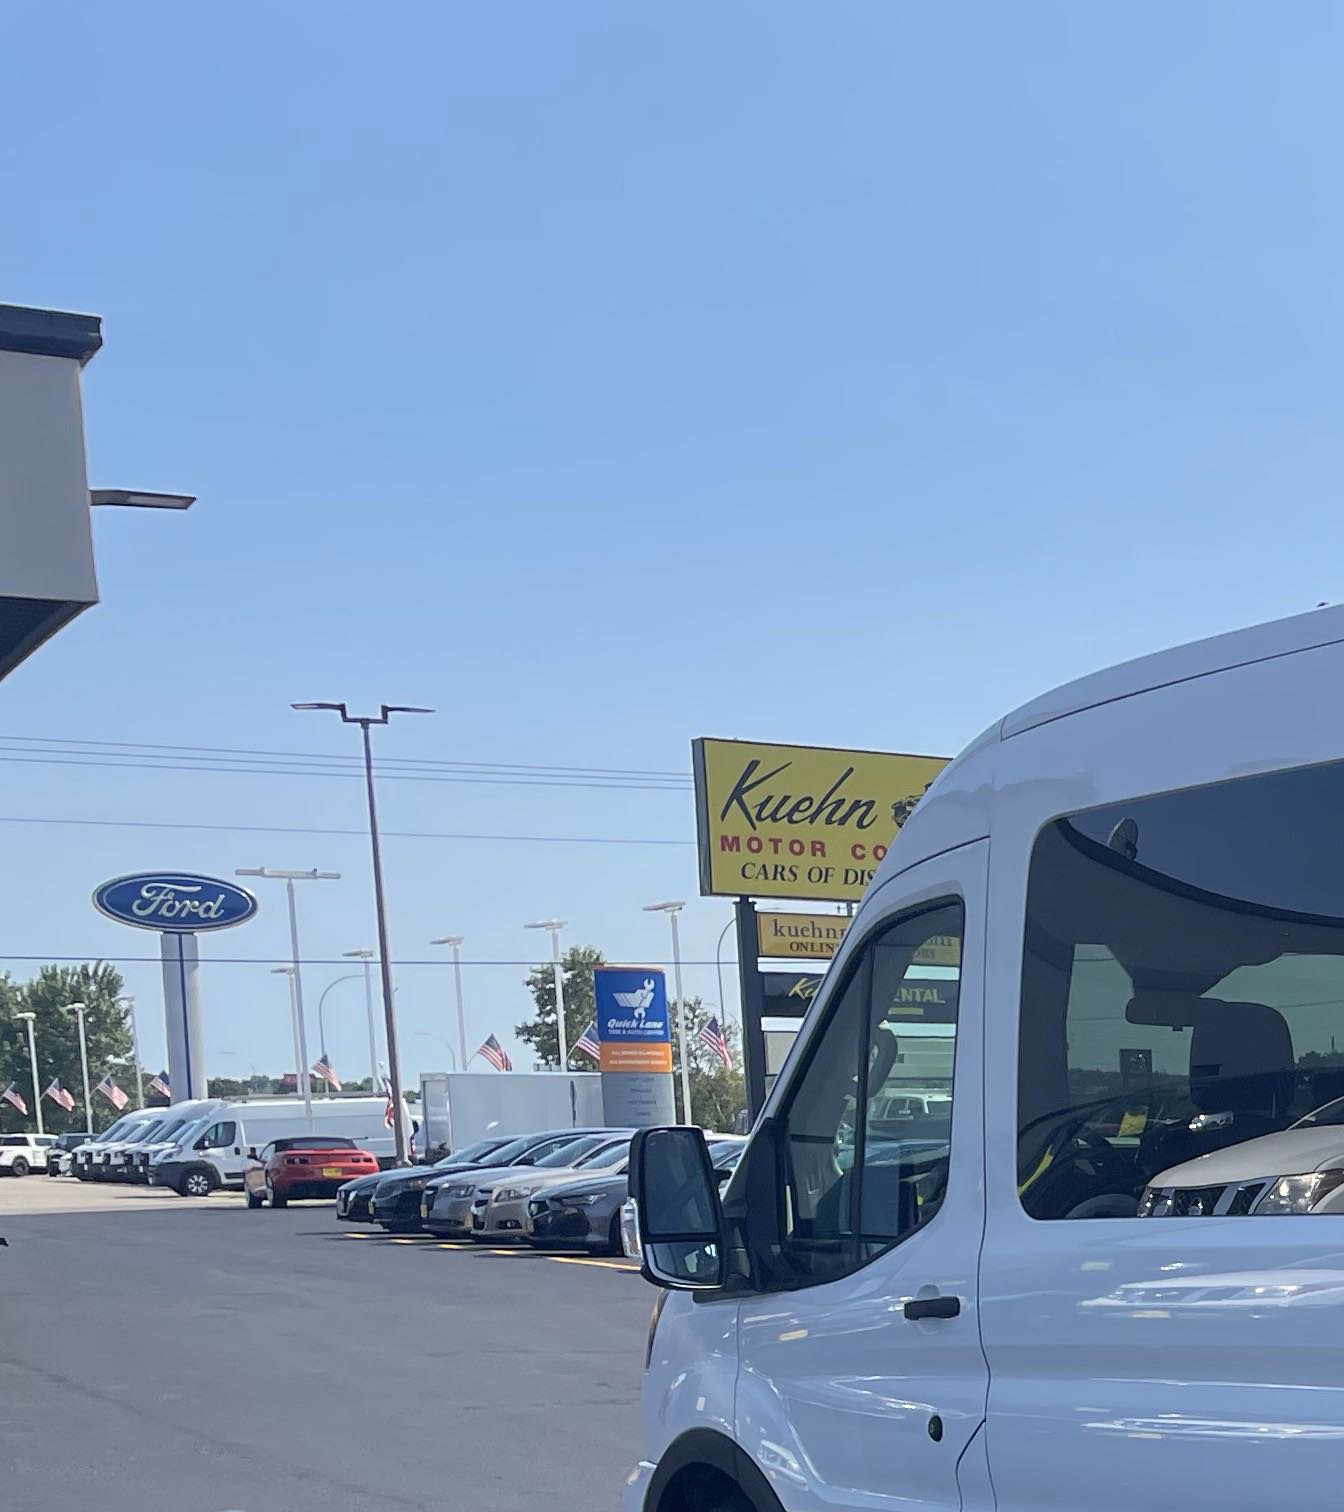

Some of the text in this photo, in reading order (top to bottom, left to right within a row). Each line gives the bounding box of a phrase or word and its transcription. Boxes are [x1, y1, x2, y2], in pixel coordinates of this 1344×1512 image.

[720, 759, 877, 831] Kuehn
[720, 835, 827, 858] MOTOR
[741, 862, 799, 884] CARS
[807, 866, 835, 885] OF
[132, 882, 225, 919] Ford
[789, 941, 838, 953] ONLIN
